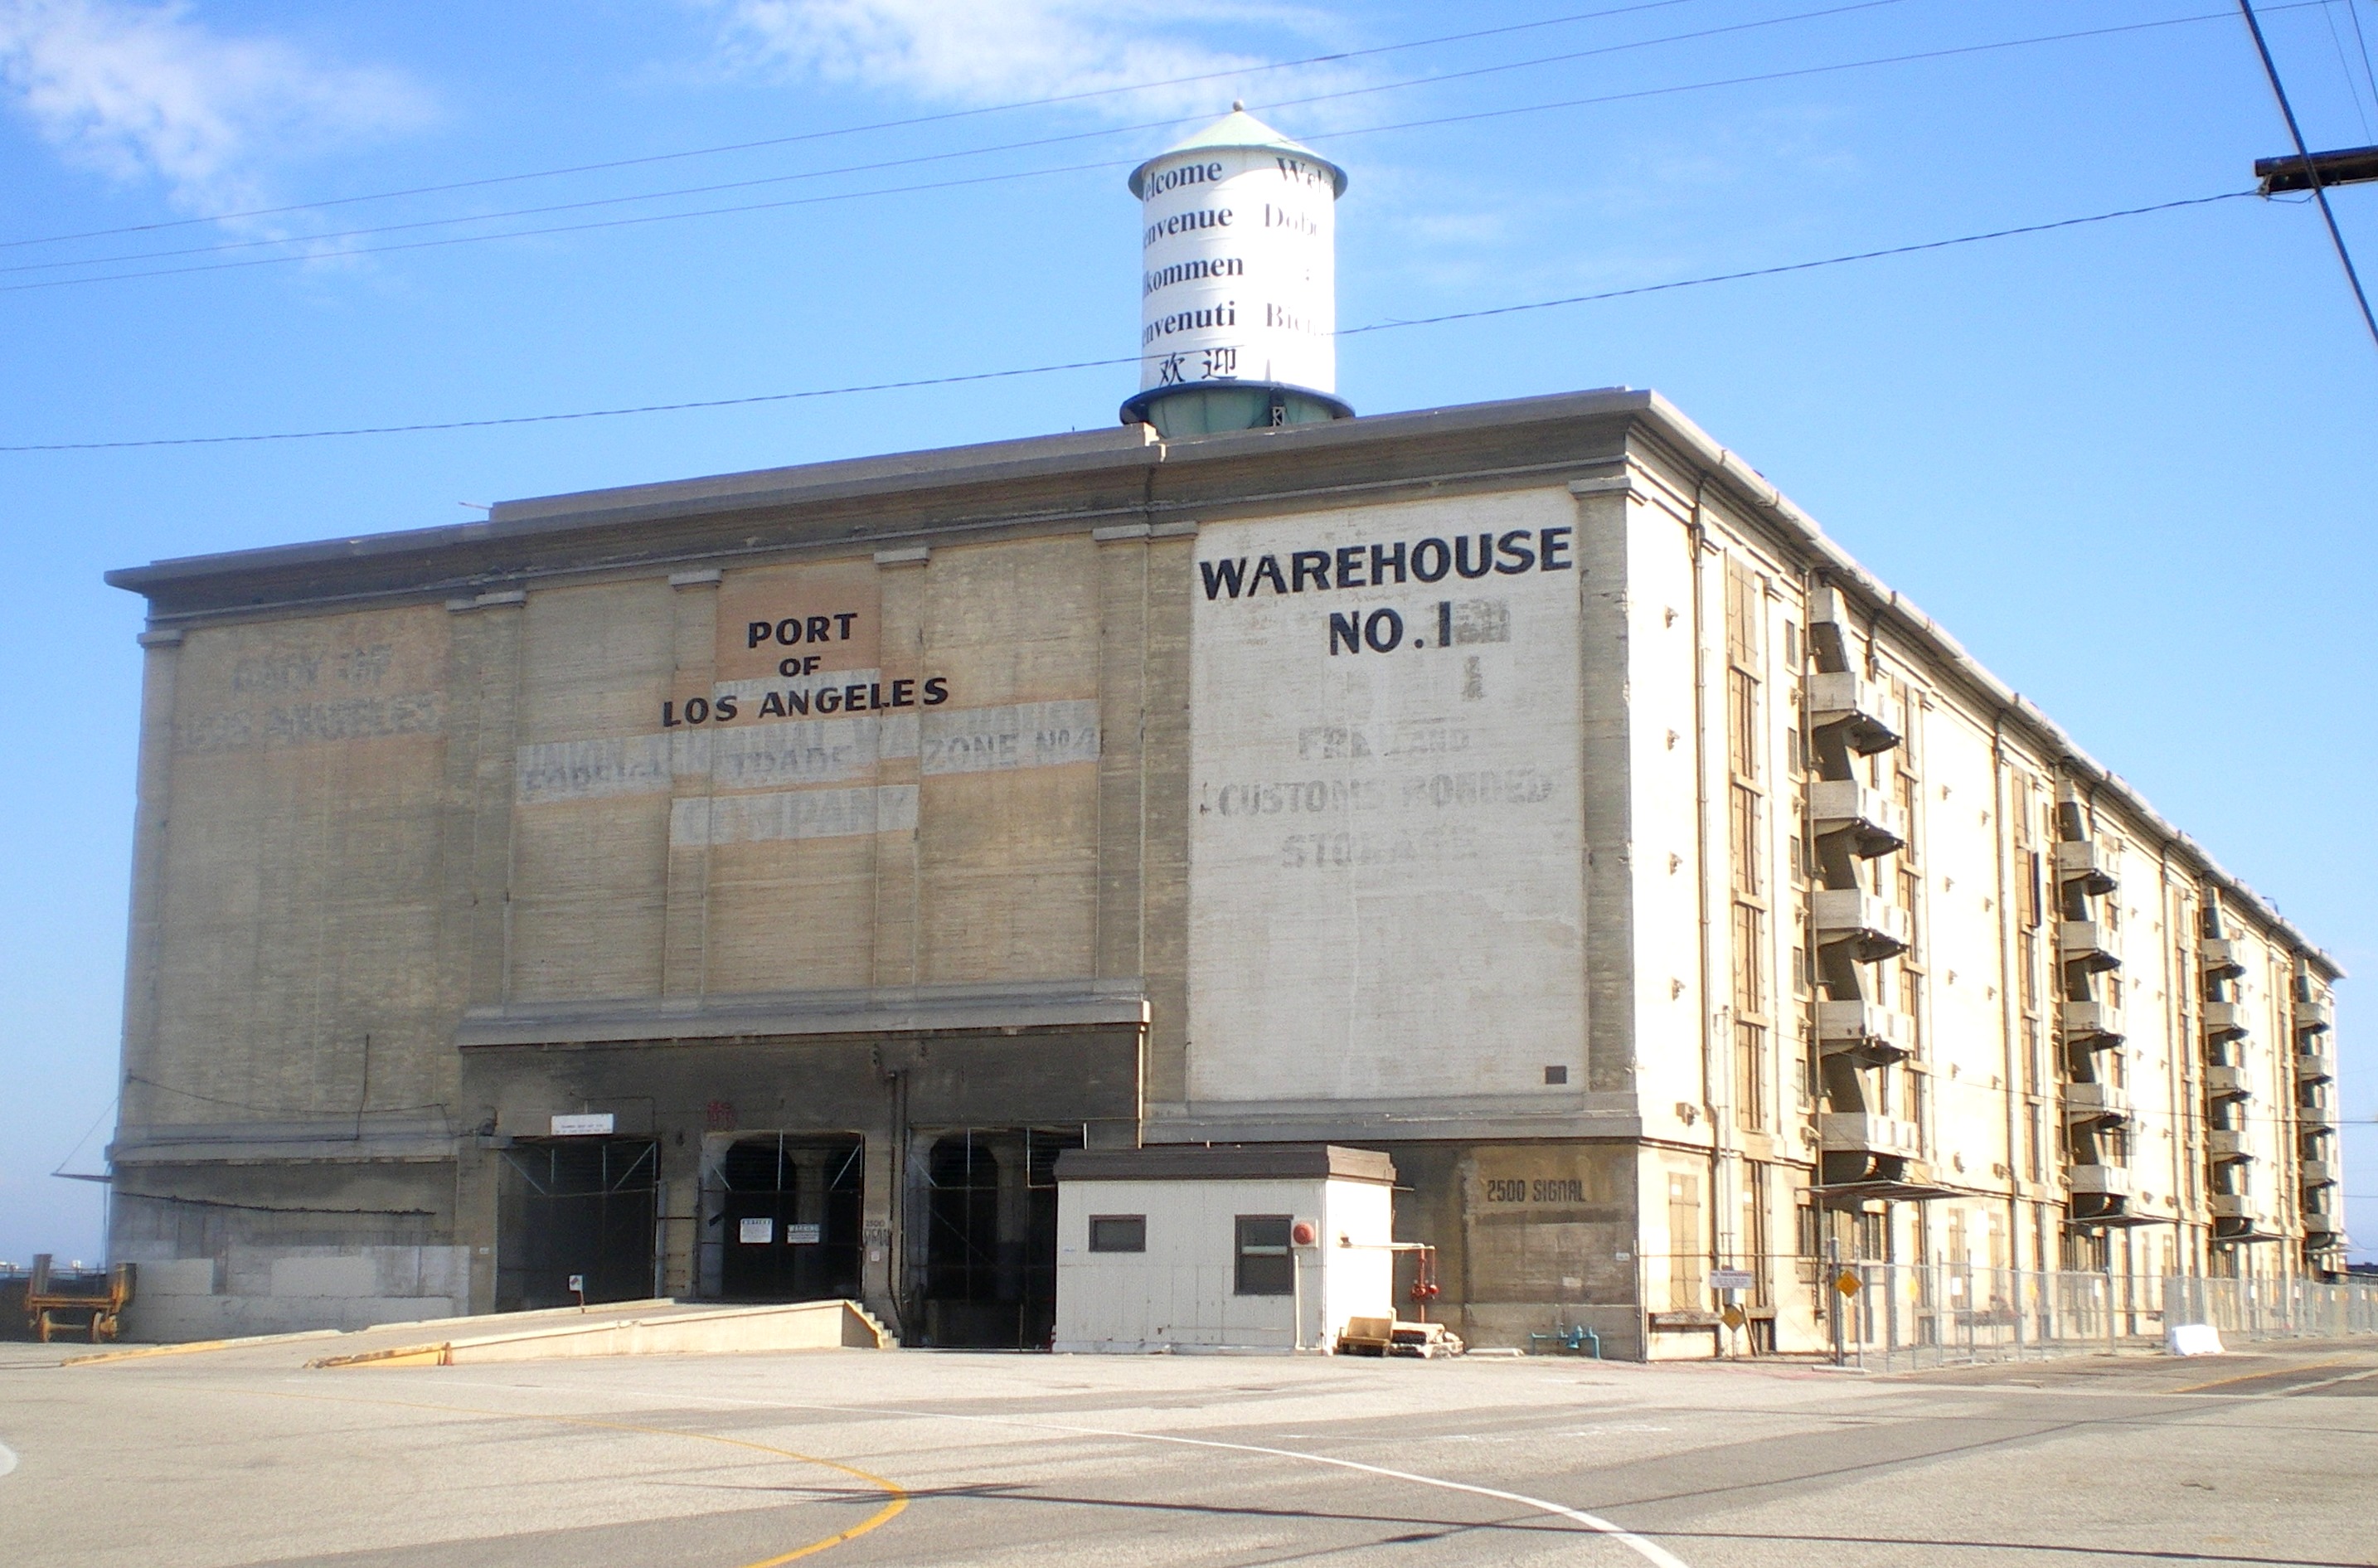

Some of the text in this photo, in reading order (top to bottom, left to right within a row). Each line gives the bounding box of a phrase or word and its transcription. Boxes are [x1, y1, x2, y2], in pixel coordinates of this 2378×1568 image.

[1199, 527, 1573, 600] WAREHOUSE
[747, 612, 858, 648] PORT
[779, 656, 822, 677] OF
[662, 694, 739, 728] LOS
[758, 677, 949, 719] ANGELES
[1487, 1178, 1587, 1202] 2500 SIGNAL
